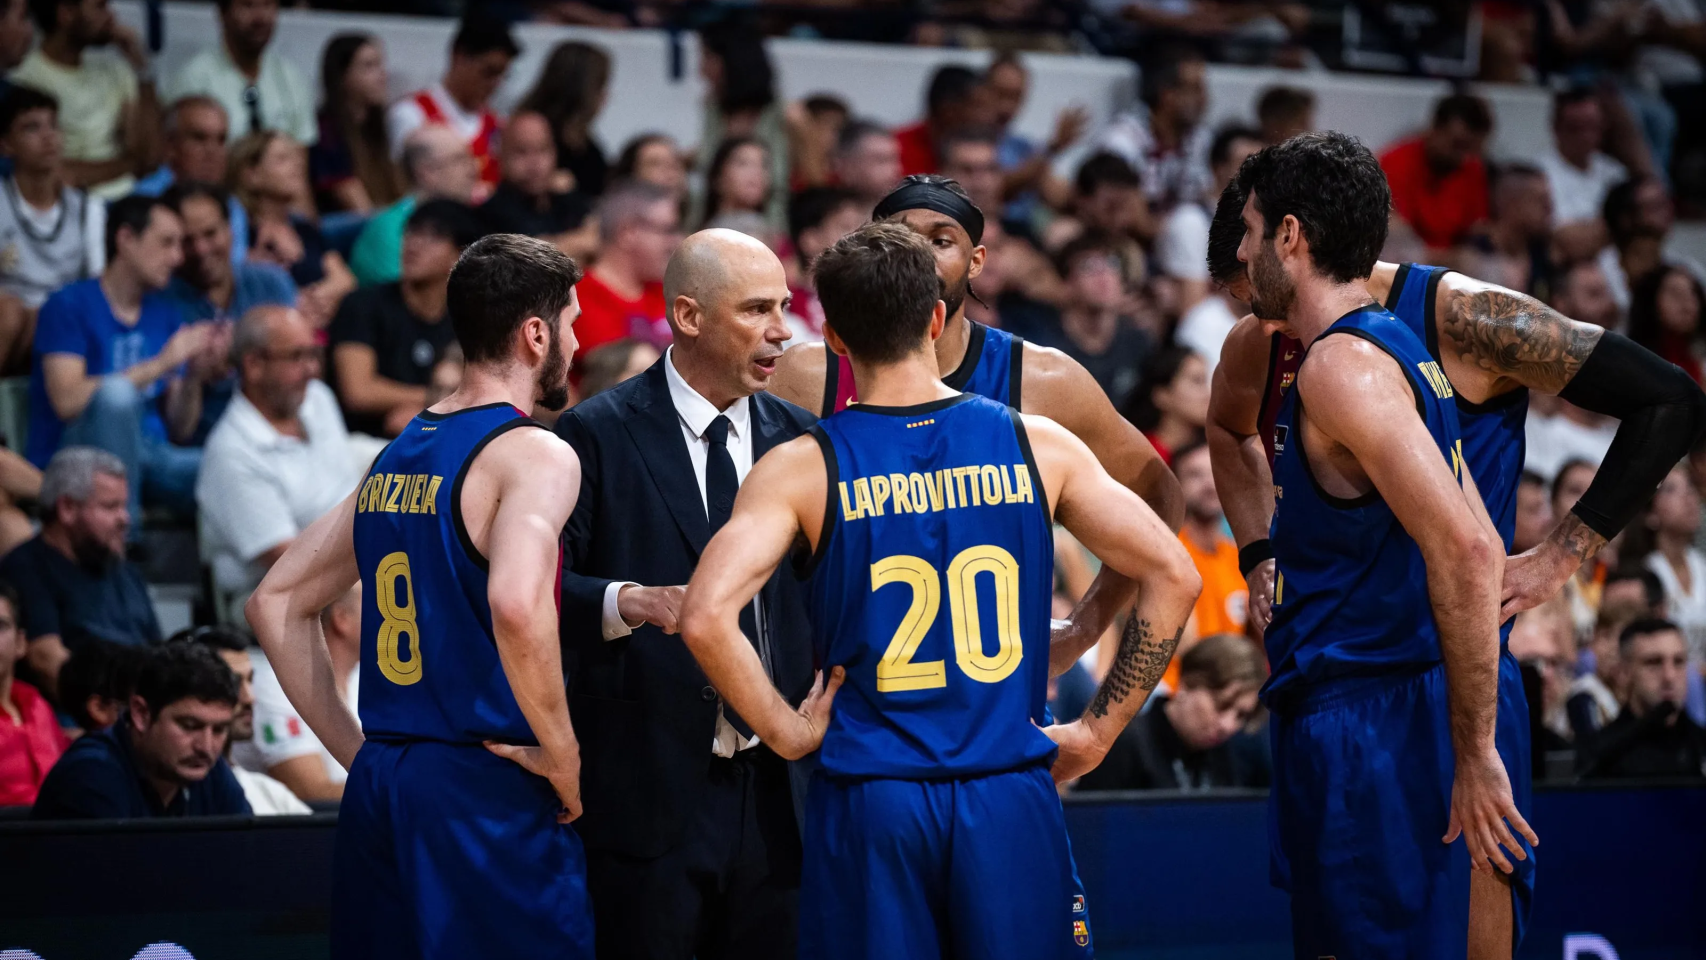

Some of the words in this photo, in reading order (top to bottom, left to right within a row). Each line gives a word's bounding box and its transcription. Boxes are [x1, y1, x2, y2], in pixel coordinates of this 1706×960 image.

[838, 464, 1034, 522] LAPROVITTOLA
[375, 551, 423, 686] 8
[870, 544, 1024, 693] 20
